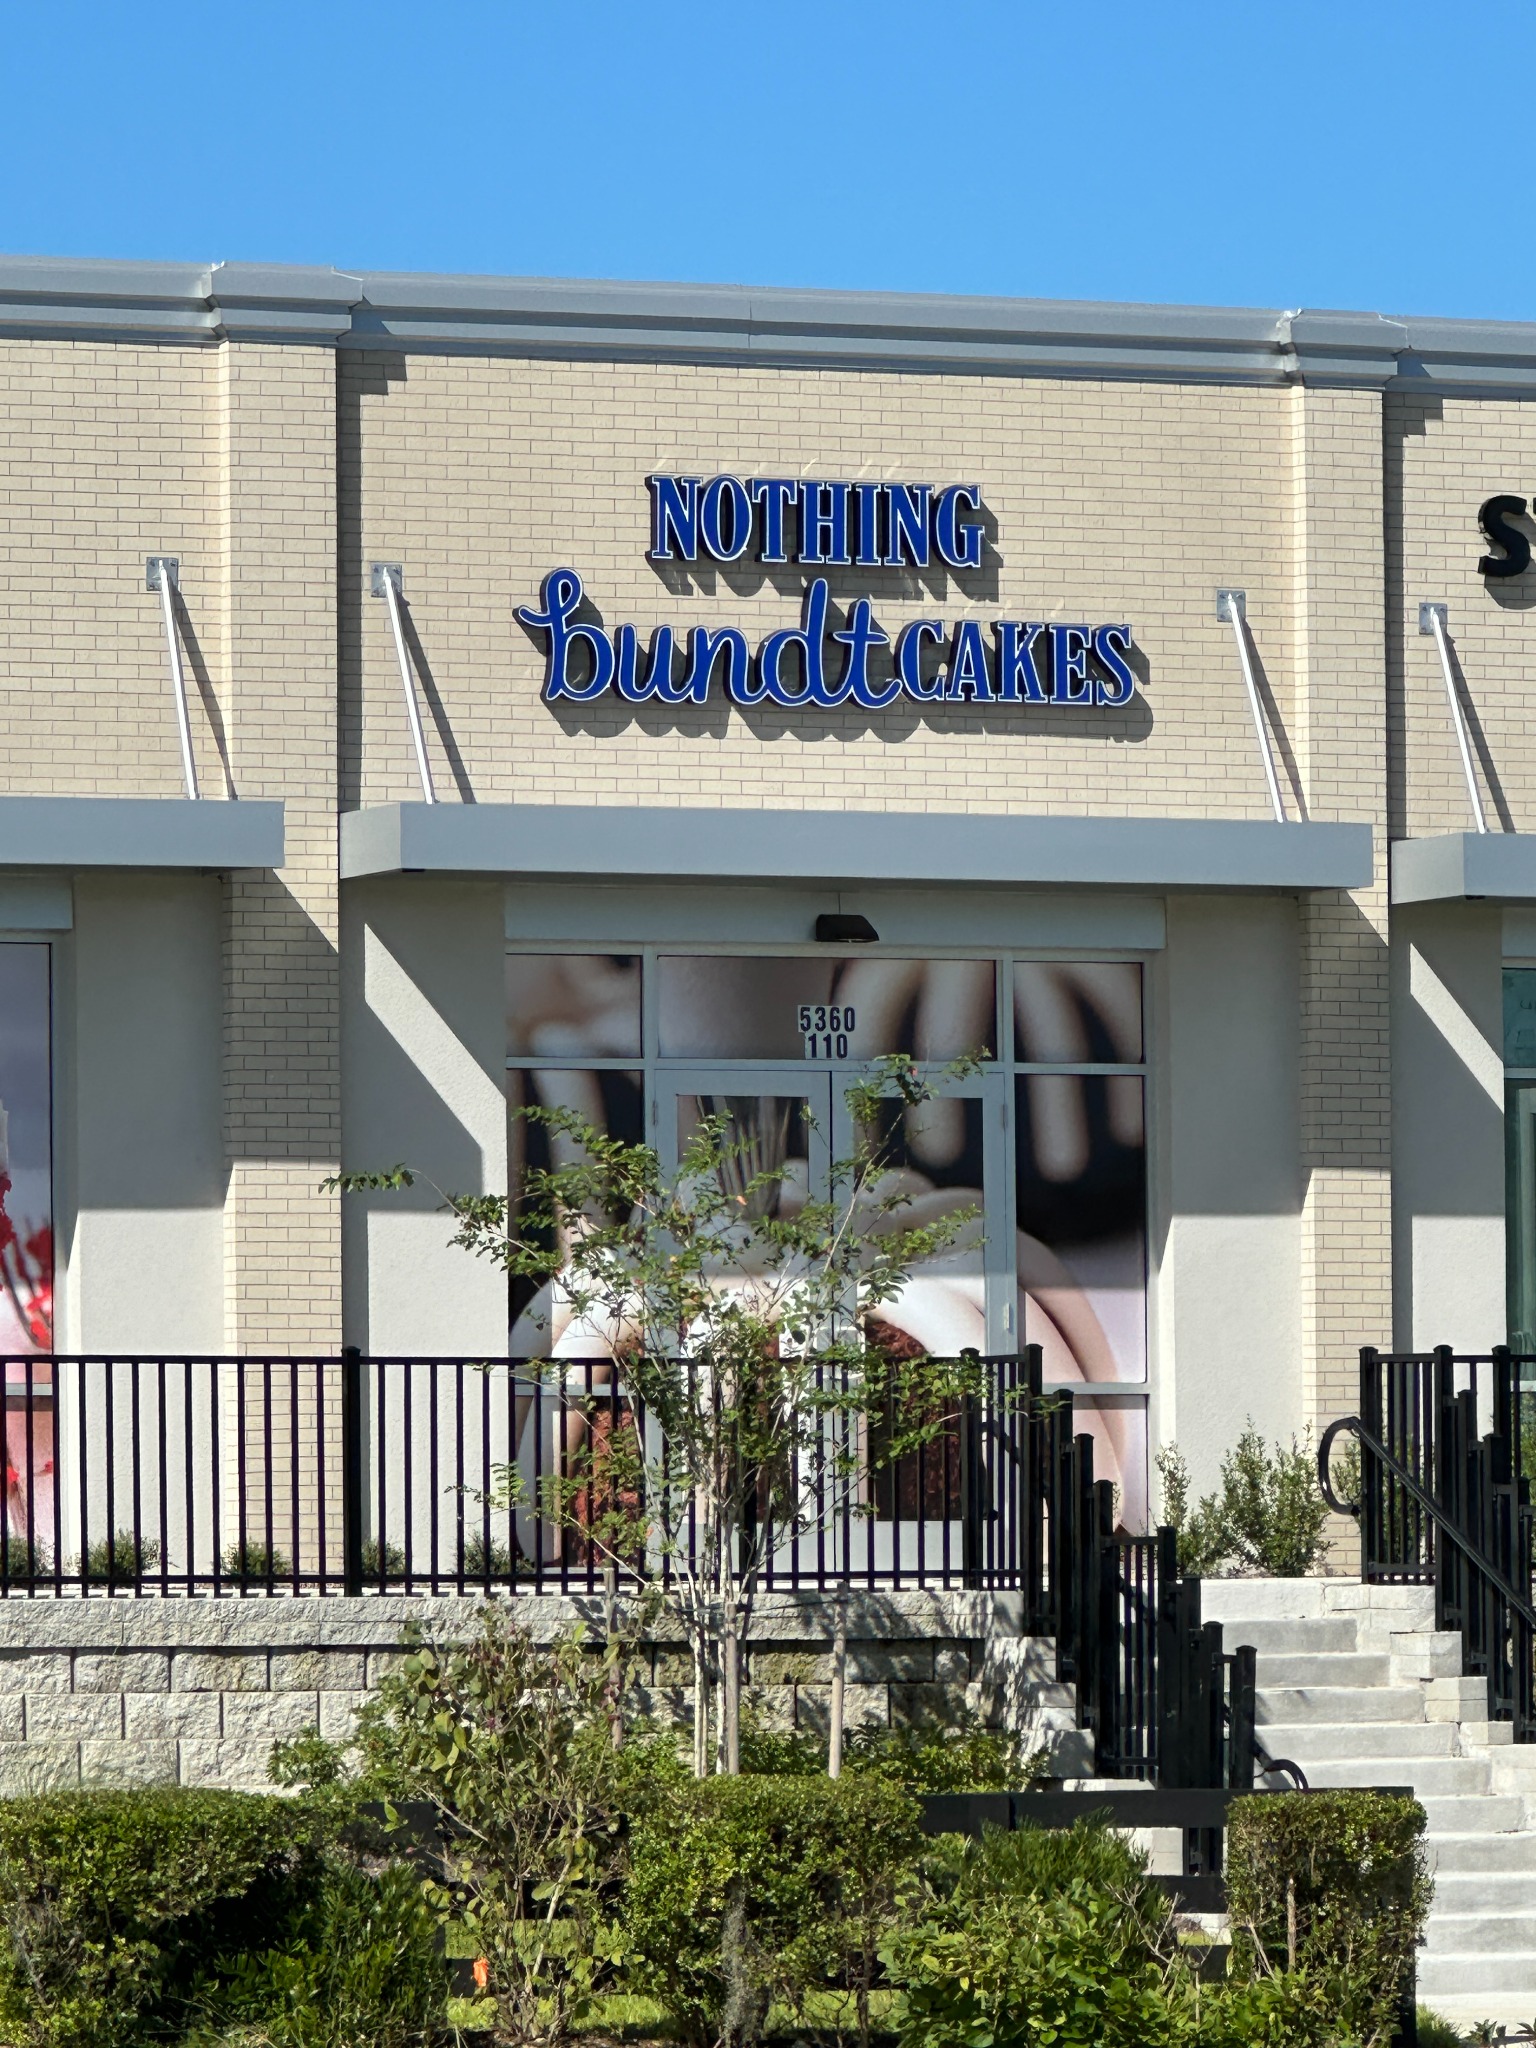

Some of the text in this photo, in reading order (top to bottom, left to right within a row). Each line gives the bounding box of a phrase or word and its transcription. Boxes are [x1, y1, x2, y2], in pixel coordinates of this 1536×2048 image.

[648, 474, 984, 568] NOTHING
[1477, 494, 1536, 577] S
[515, 567, 1135, 709] bundt CAKES
[800, 1006, 855, 1032] 5360
[808, 1033, 848, 1058] 110
